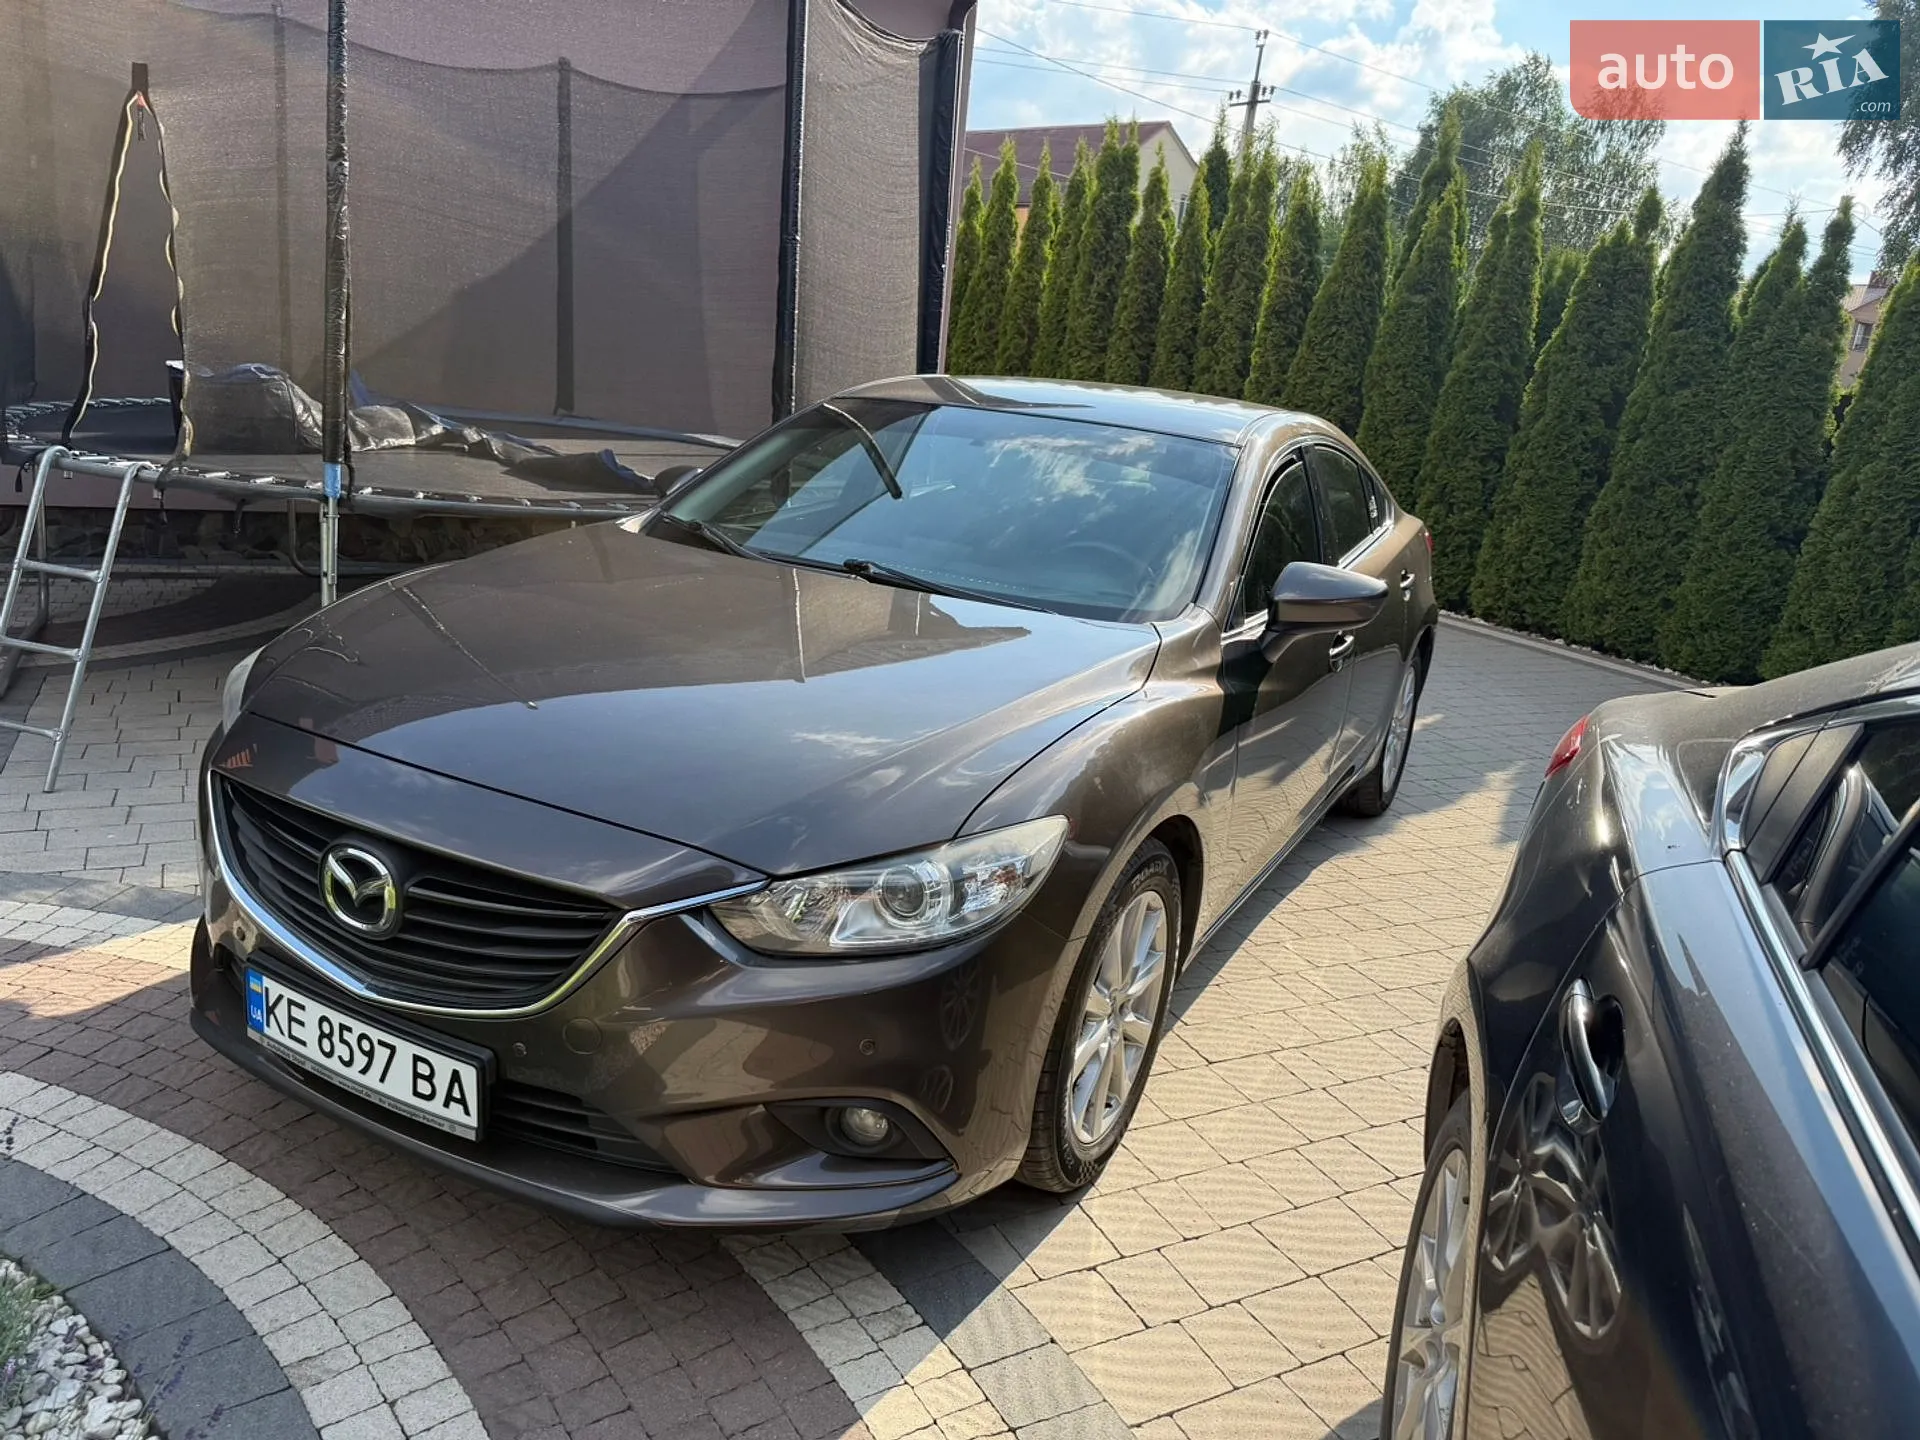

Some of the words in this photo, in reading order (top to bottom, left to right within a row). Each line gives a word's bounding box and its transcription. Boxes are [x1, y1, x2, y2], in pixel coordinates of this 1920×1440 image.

[250, 1004, 263, 1023] UA
[264, 986, 308, 1047] KE
[317, 1014, 397, 1084] 8597
[412, 1053, 471, 1117] BA
